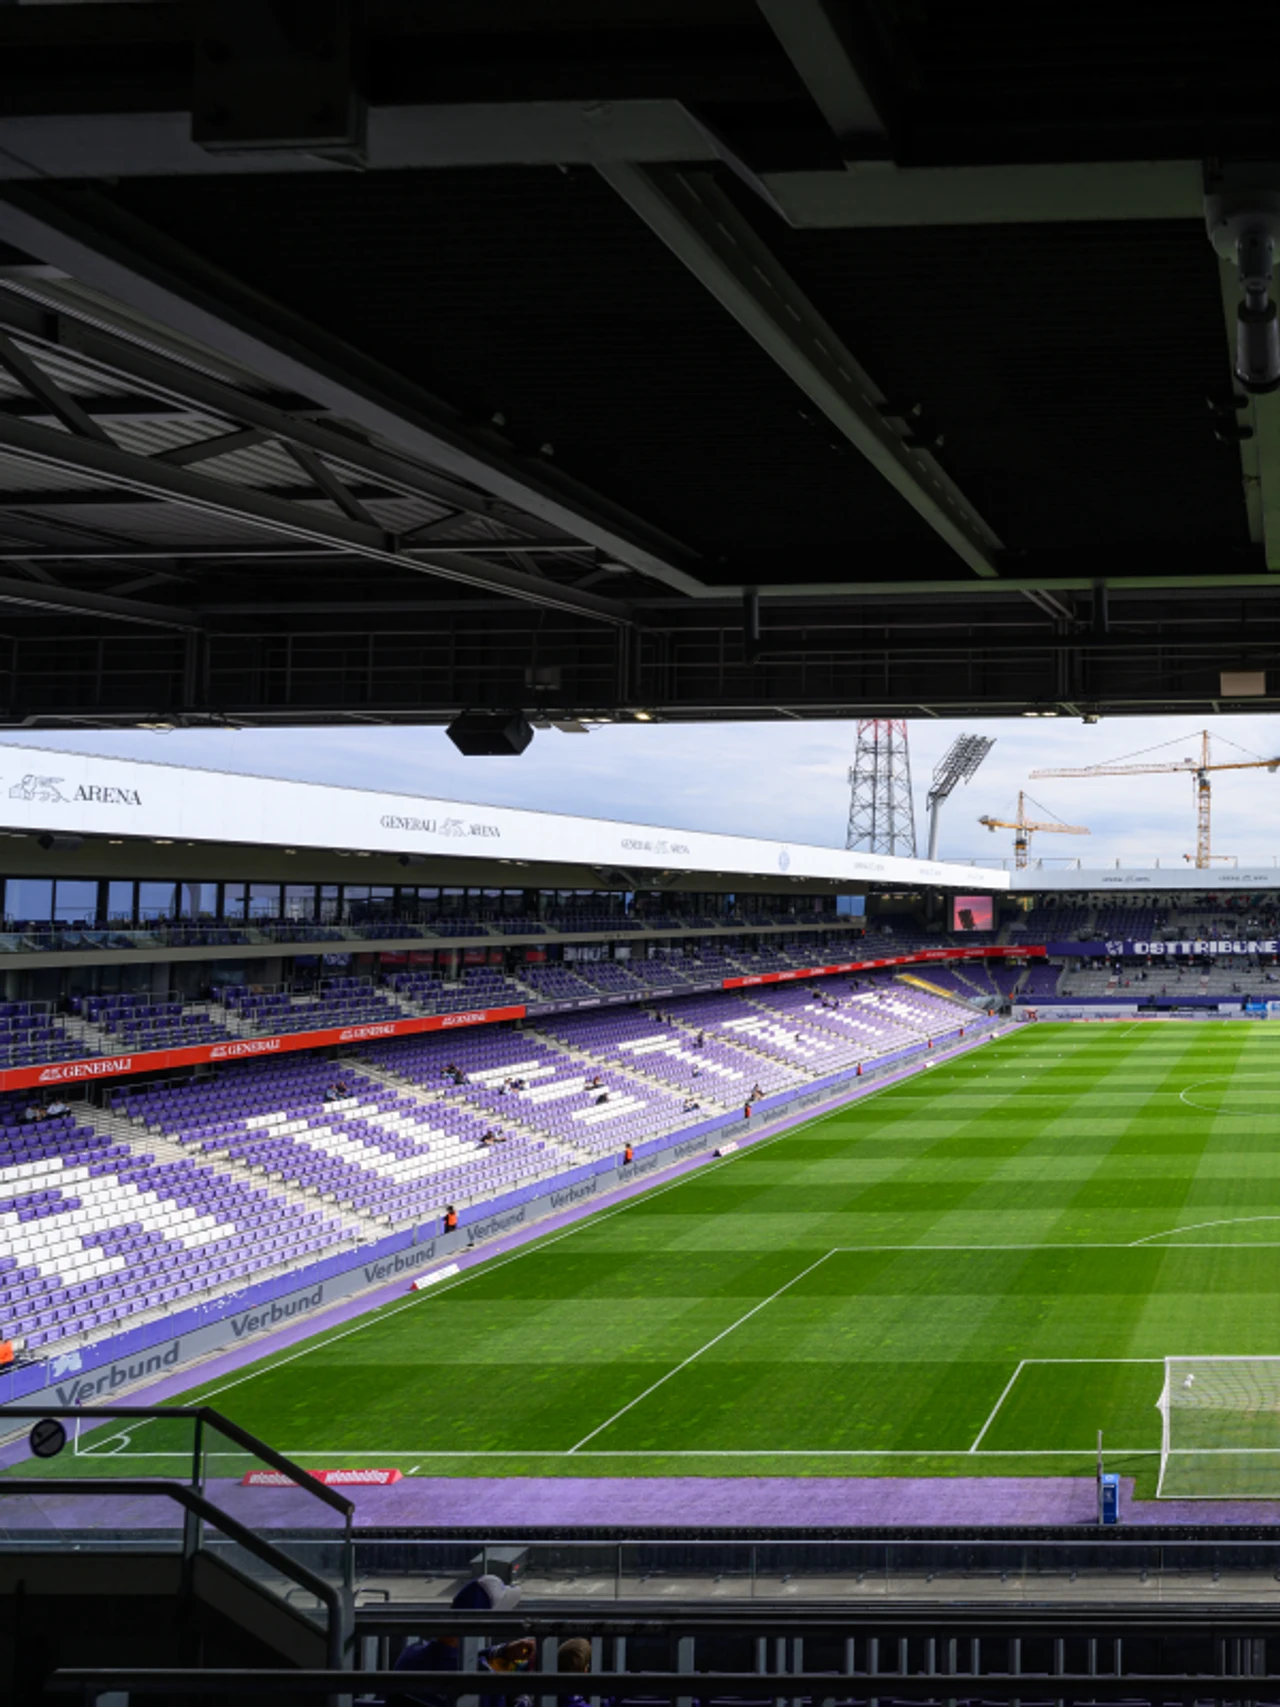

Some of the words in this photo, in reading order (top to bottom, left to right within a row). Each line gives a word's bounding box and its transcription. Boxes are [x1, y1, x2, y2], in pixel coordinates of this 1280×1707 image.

[74, 784, 142, 806] ARENA
[380, 815, 437, 834] GENERALI
[466, 822, 501, 838] ARENA
[228, 1039, 280, 1056] GENERALI
[62, 1059, 132, 1078] GENERALI
[550, 1176, 597, 1209] Verbund
[467, 1207, 526, 1243] Verbund
[364, 1243, 435, 1283] Verbund
[231, 1285, 323, 1338] Verbund
[55, 1341, 180, 1408] Verbund
